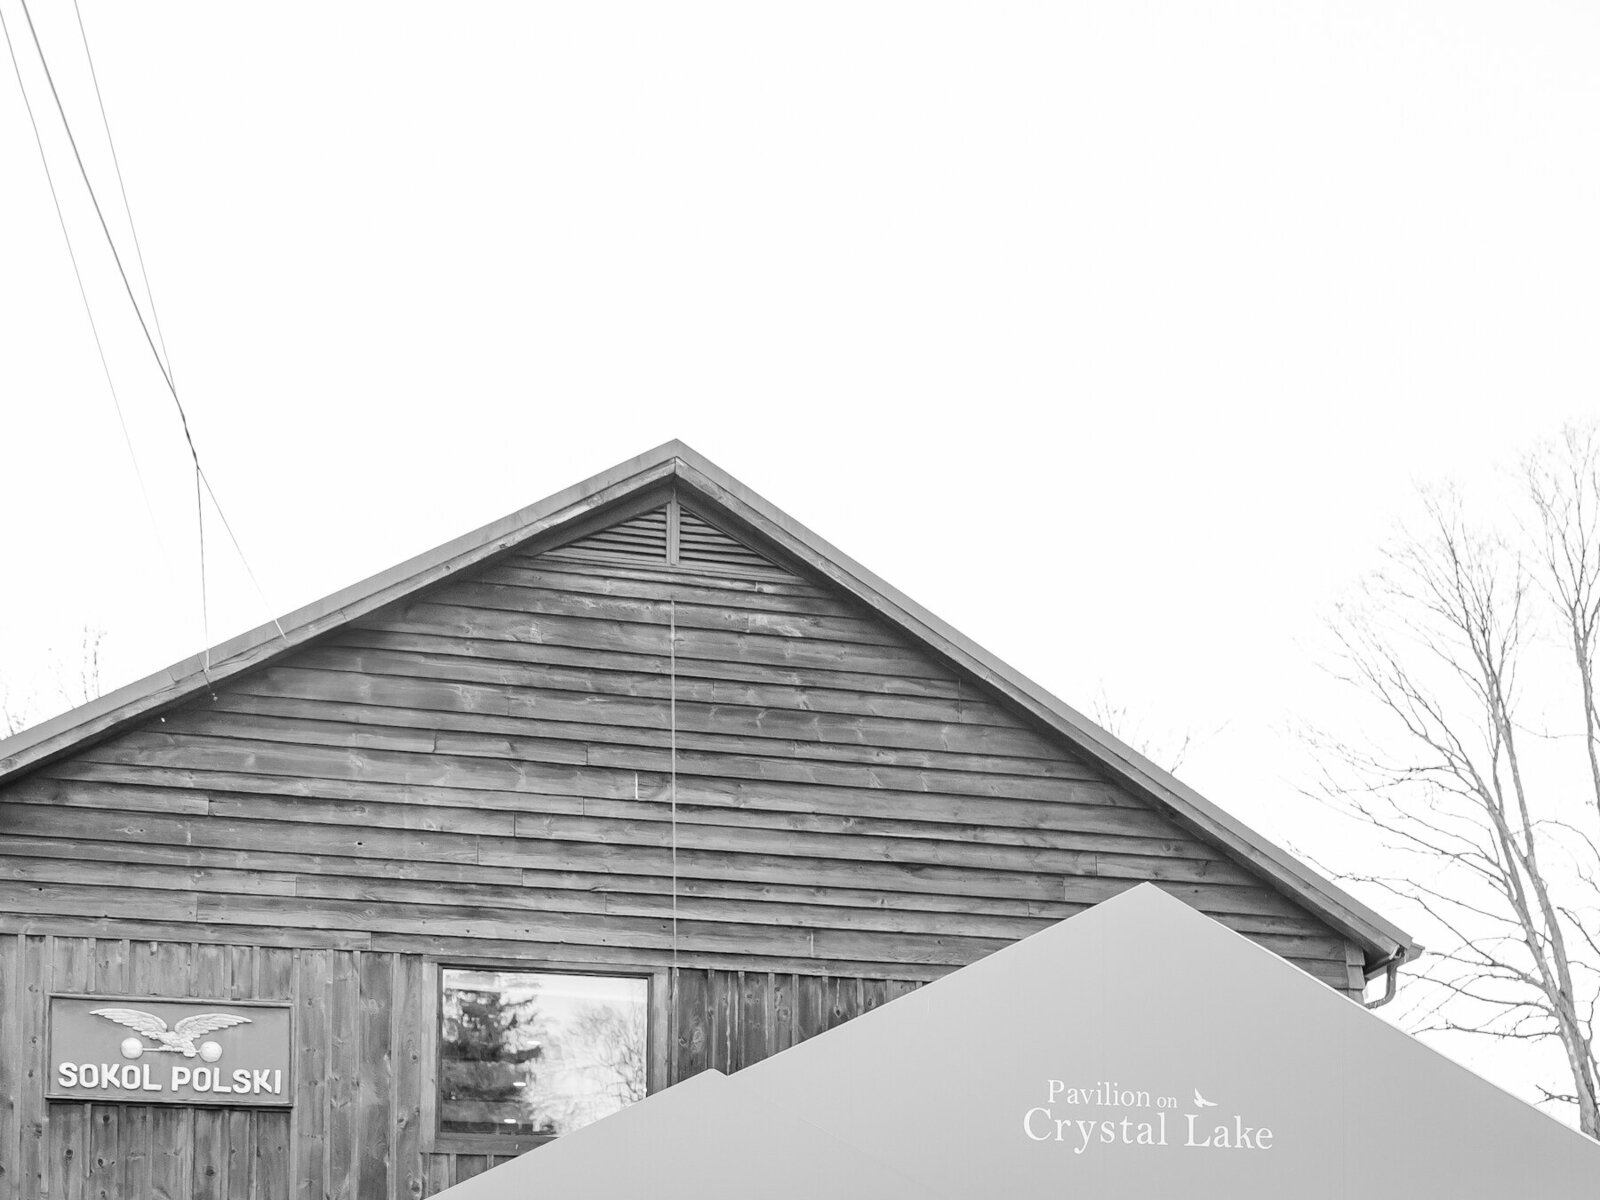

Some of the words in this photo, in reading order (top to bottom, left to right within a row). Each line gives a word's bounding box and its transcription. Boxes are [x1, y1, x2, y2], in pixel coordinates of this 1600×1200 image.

[58, 1062, 163, 1091] SOKOL
[171, 1066, 282, 1095] POLSKI
[1047, 1079, 1151, 1108] Pavilion
[1156, 1095, 1177, 1109] on
[1023, 1107, 1169, 1154] Crystal
[1184, 1113, 1273, 1150] Lake
